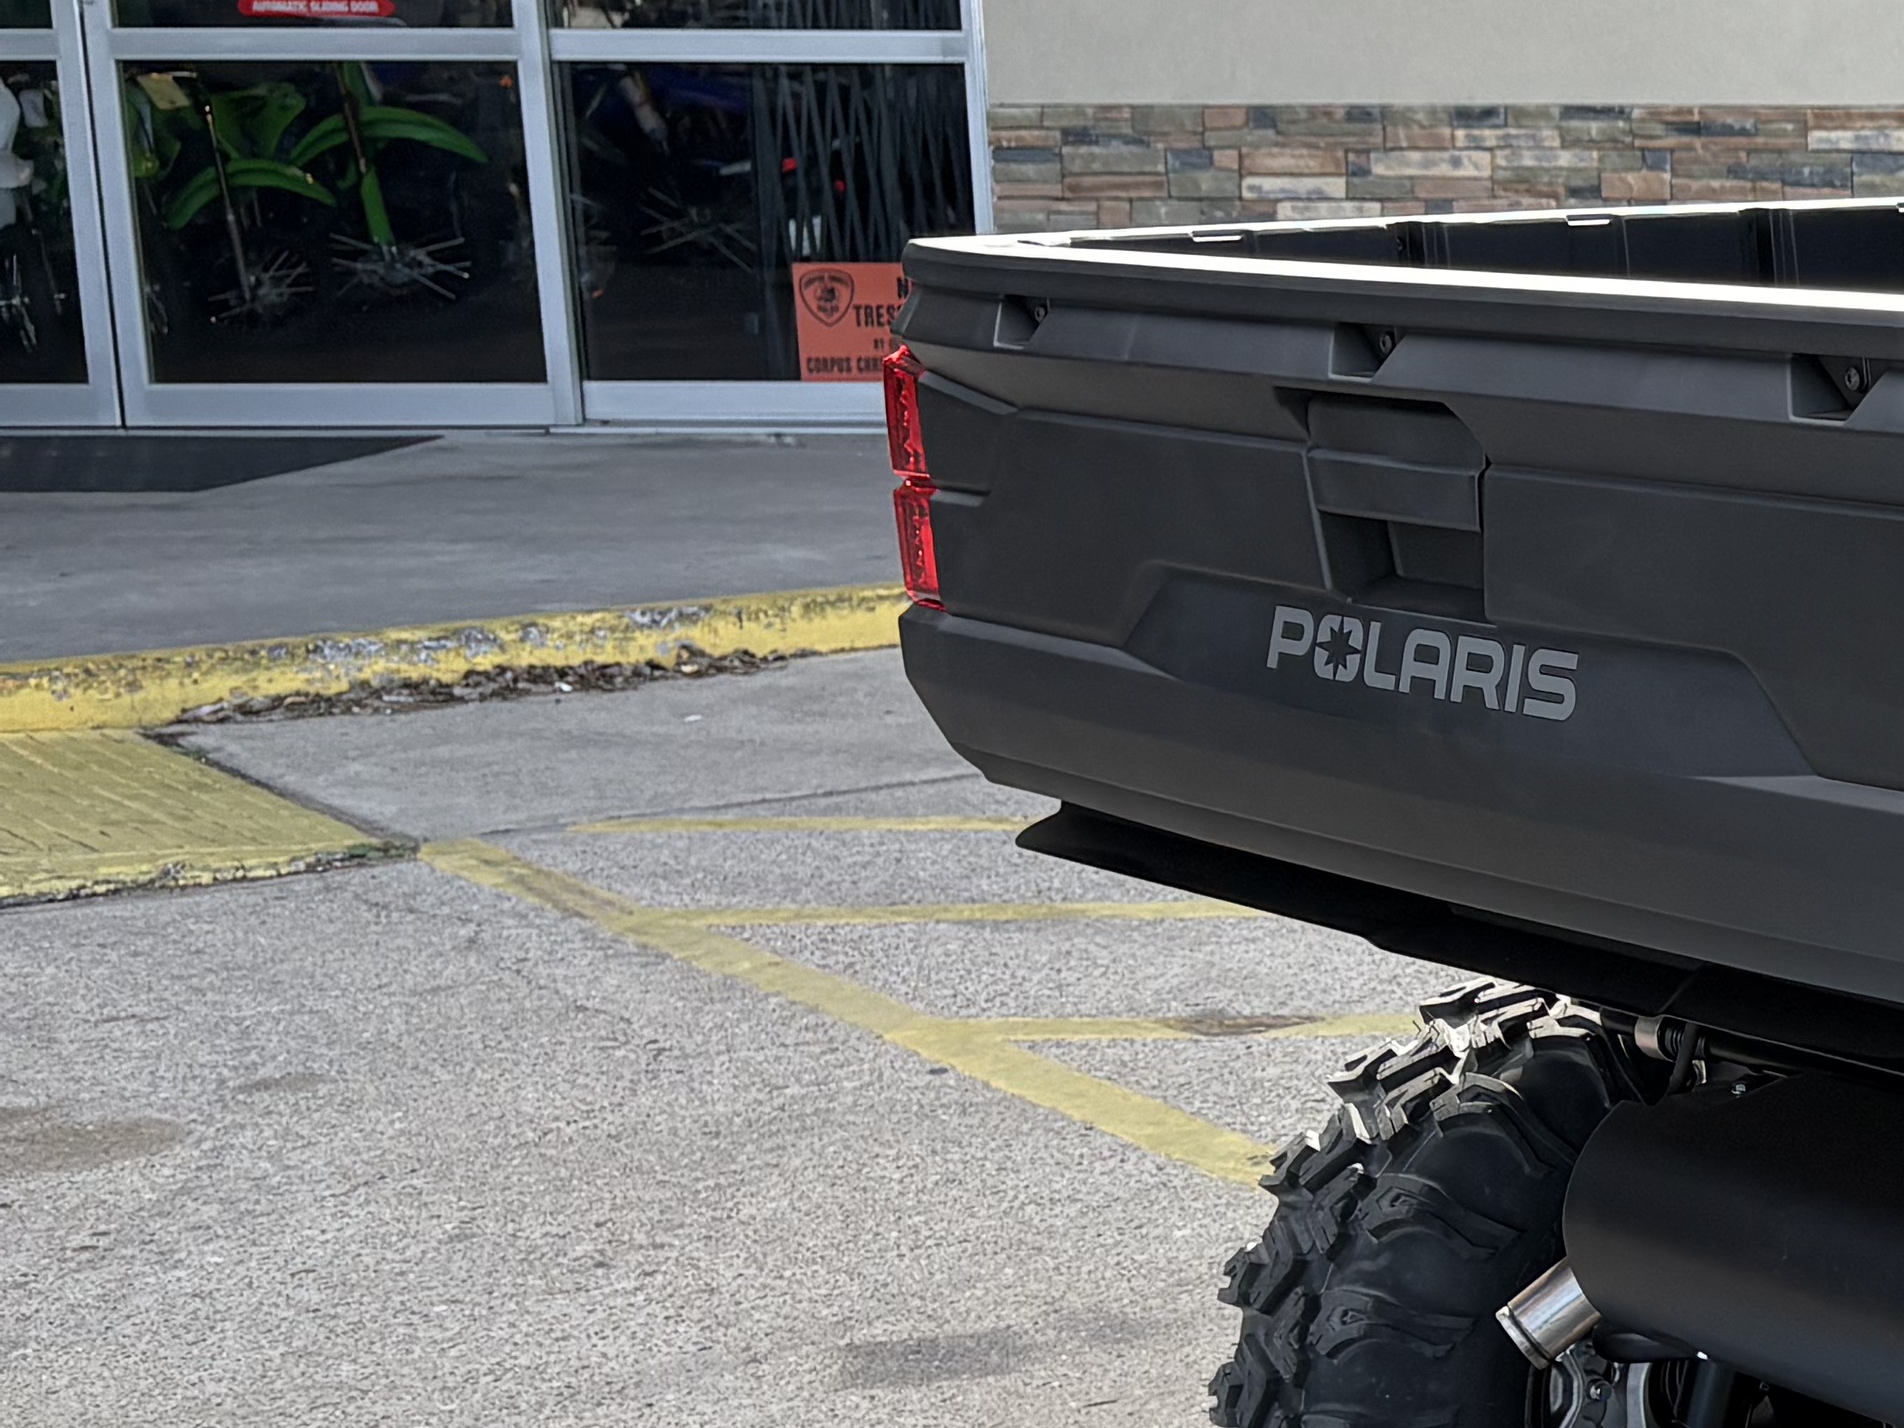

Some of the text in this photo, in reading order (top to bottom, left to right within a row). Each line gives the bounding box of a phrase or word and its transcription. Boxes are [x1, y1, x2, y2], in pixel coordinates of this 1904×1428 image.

[897, 276, 909, 300] N
[807, 356, 852, 374] CORPUS
[1266, 604, 1579, 722] POLARIS
